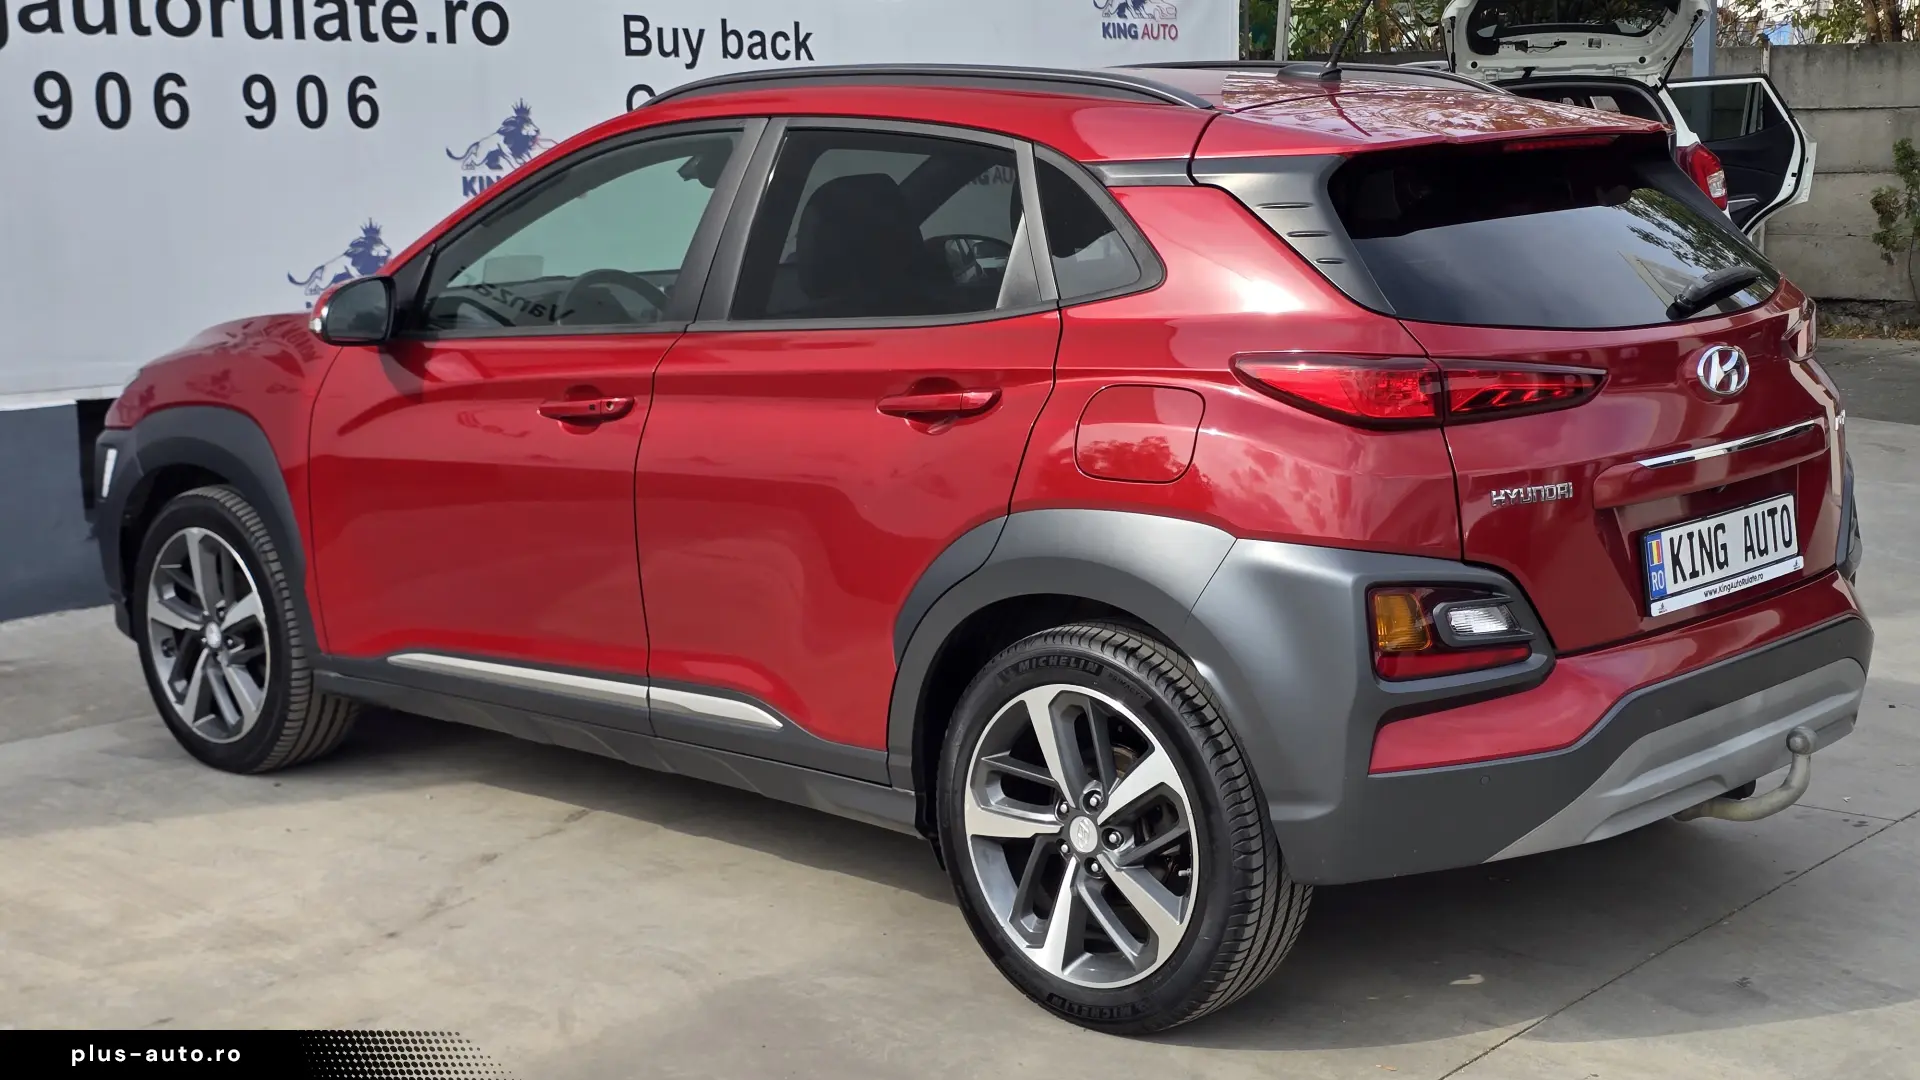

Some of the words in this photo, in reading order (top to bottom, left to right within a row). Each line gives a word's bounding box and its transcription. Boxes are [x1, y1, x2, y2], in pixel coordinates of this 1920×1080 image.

[0, 0, 510, 49] autorulate.ro
[1101, 22, 1139, 40] KING
[1140, 23, 1179, 41] AUTO
[623, 14, 705, 70] Buy
[720, 18, 815, 62] back
[33, 70, 190, 130] 906
[242, 73, 380, 130] 906
[1491, 482, 1573, 507] HYUNDAI
[1669, 522, 1729, 585] KING
[1743, 503, 1793, 563] AUTO
[1651, 571, 1665, 592] RO
[1703, 573, 1764, 598] www.KingAutoRulate.ro
[1018, 656, 1099, 674] MICHELIN
